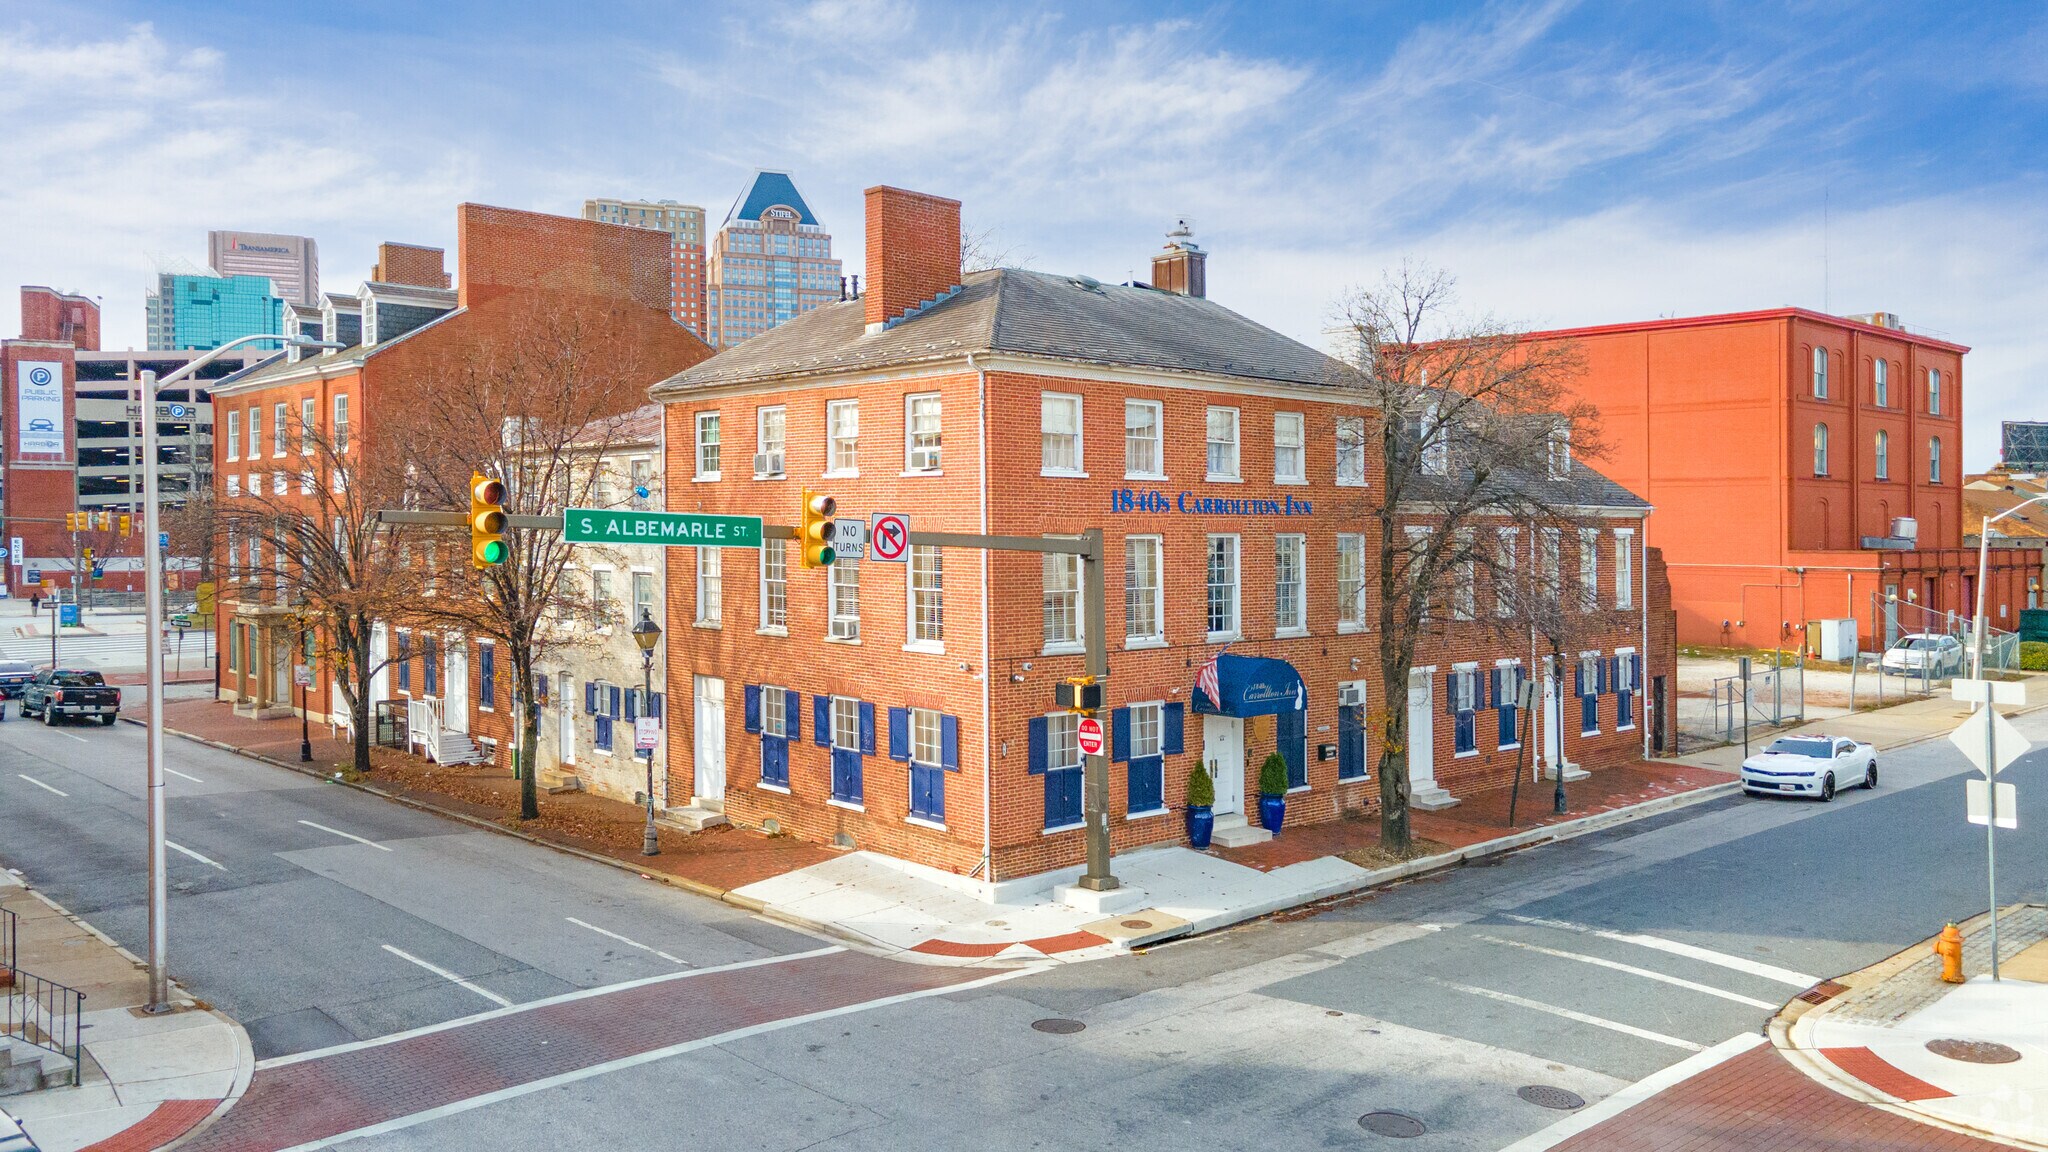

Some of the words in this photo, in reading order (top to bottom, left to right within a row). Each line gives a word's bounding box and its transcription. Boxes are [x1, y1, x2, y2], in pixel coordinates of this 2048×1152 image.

[770, 209, 793, 218] STIFEL
[239, 243, 290, 254] TRANSAMERICA
[24, 388, 57, 396] PUBLIC
[581, 518, 598, 534] S.
[606, 519, 726, 539] ALBEMARLE
[733, 526, 749, 537] ST.
[842, 525, 857, 537] NO
[835, 542, 864, 553] TURNS
[1083, 740, 1098, 748] ENTER
